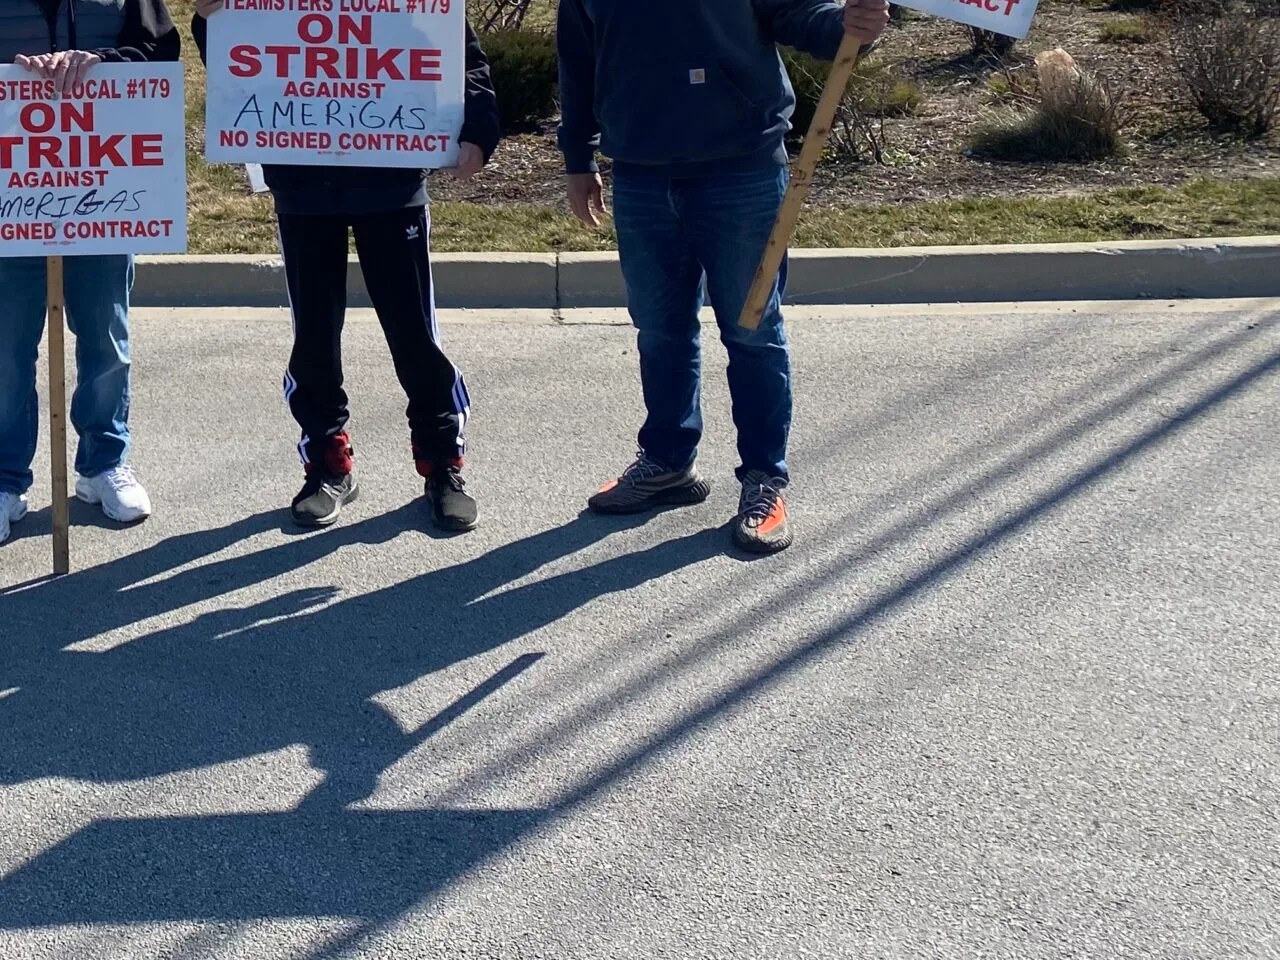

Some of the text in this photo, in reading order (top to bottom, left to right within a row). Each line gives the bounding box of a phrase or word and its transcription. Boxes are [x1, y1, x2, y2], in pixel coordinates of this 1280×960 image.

[297, 13, 372, 45] ON
[228, 44, 442, 82] STRIKE
[126, 78, 170, 98] #179
[283, 80, 385, 99] AGAINST
[19, 101, 94, 134] ON
[220, 130, 449, 152] NO SIGNED CONTRACT
[7, 169, 109, 189] AGAINST
[63, 219, 173, 240] CONTRACT
